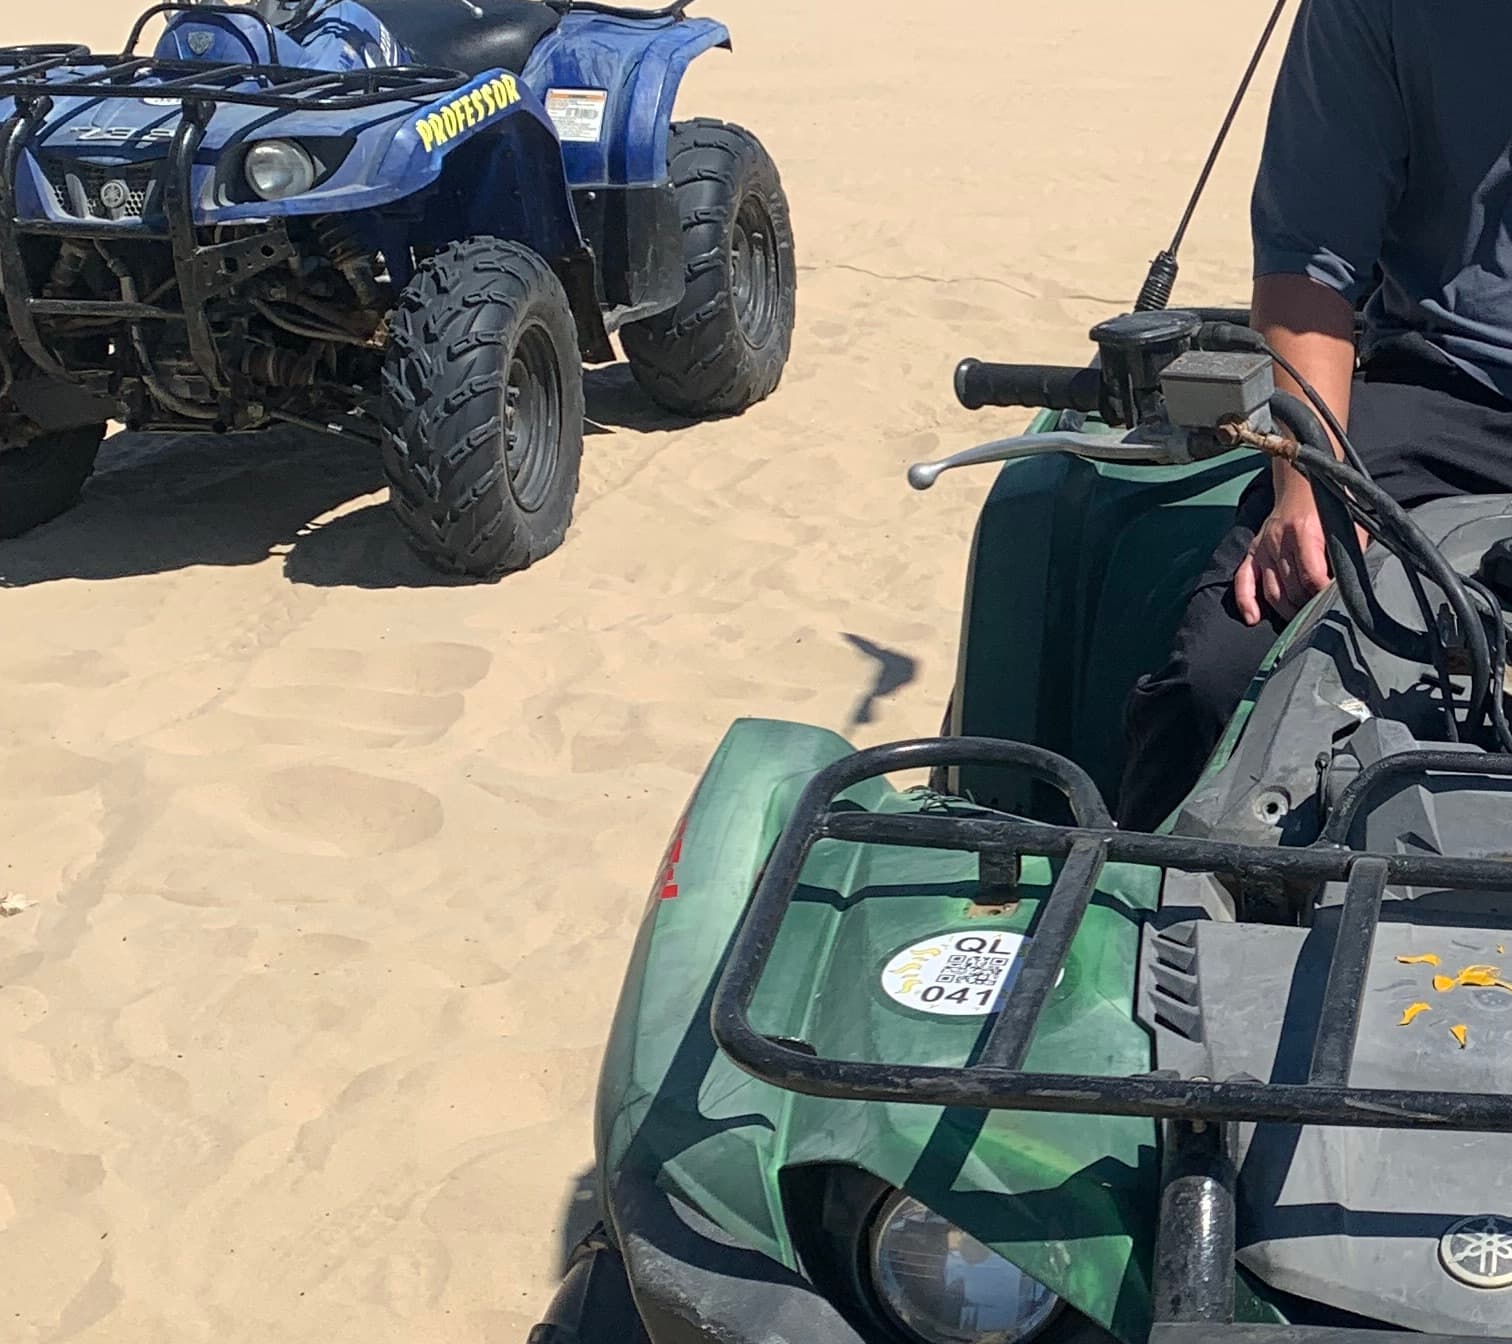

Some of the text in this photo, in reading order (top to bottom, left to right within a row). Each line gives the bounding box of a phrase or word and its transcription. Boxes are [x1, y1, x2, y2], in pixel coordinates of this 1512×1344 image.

[416, 74, 521, 152] PROFESSOR
[955, 937, 1011, 955] QL
[921, 985, 994, 1006] 041
